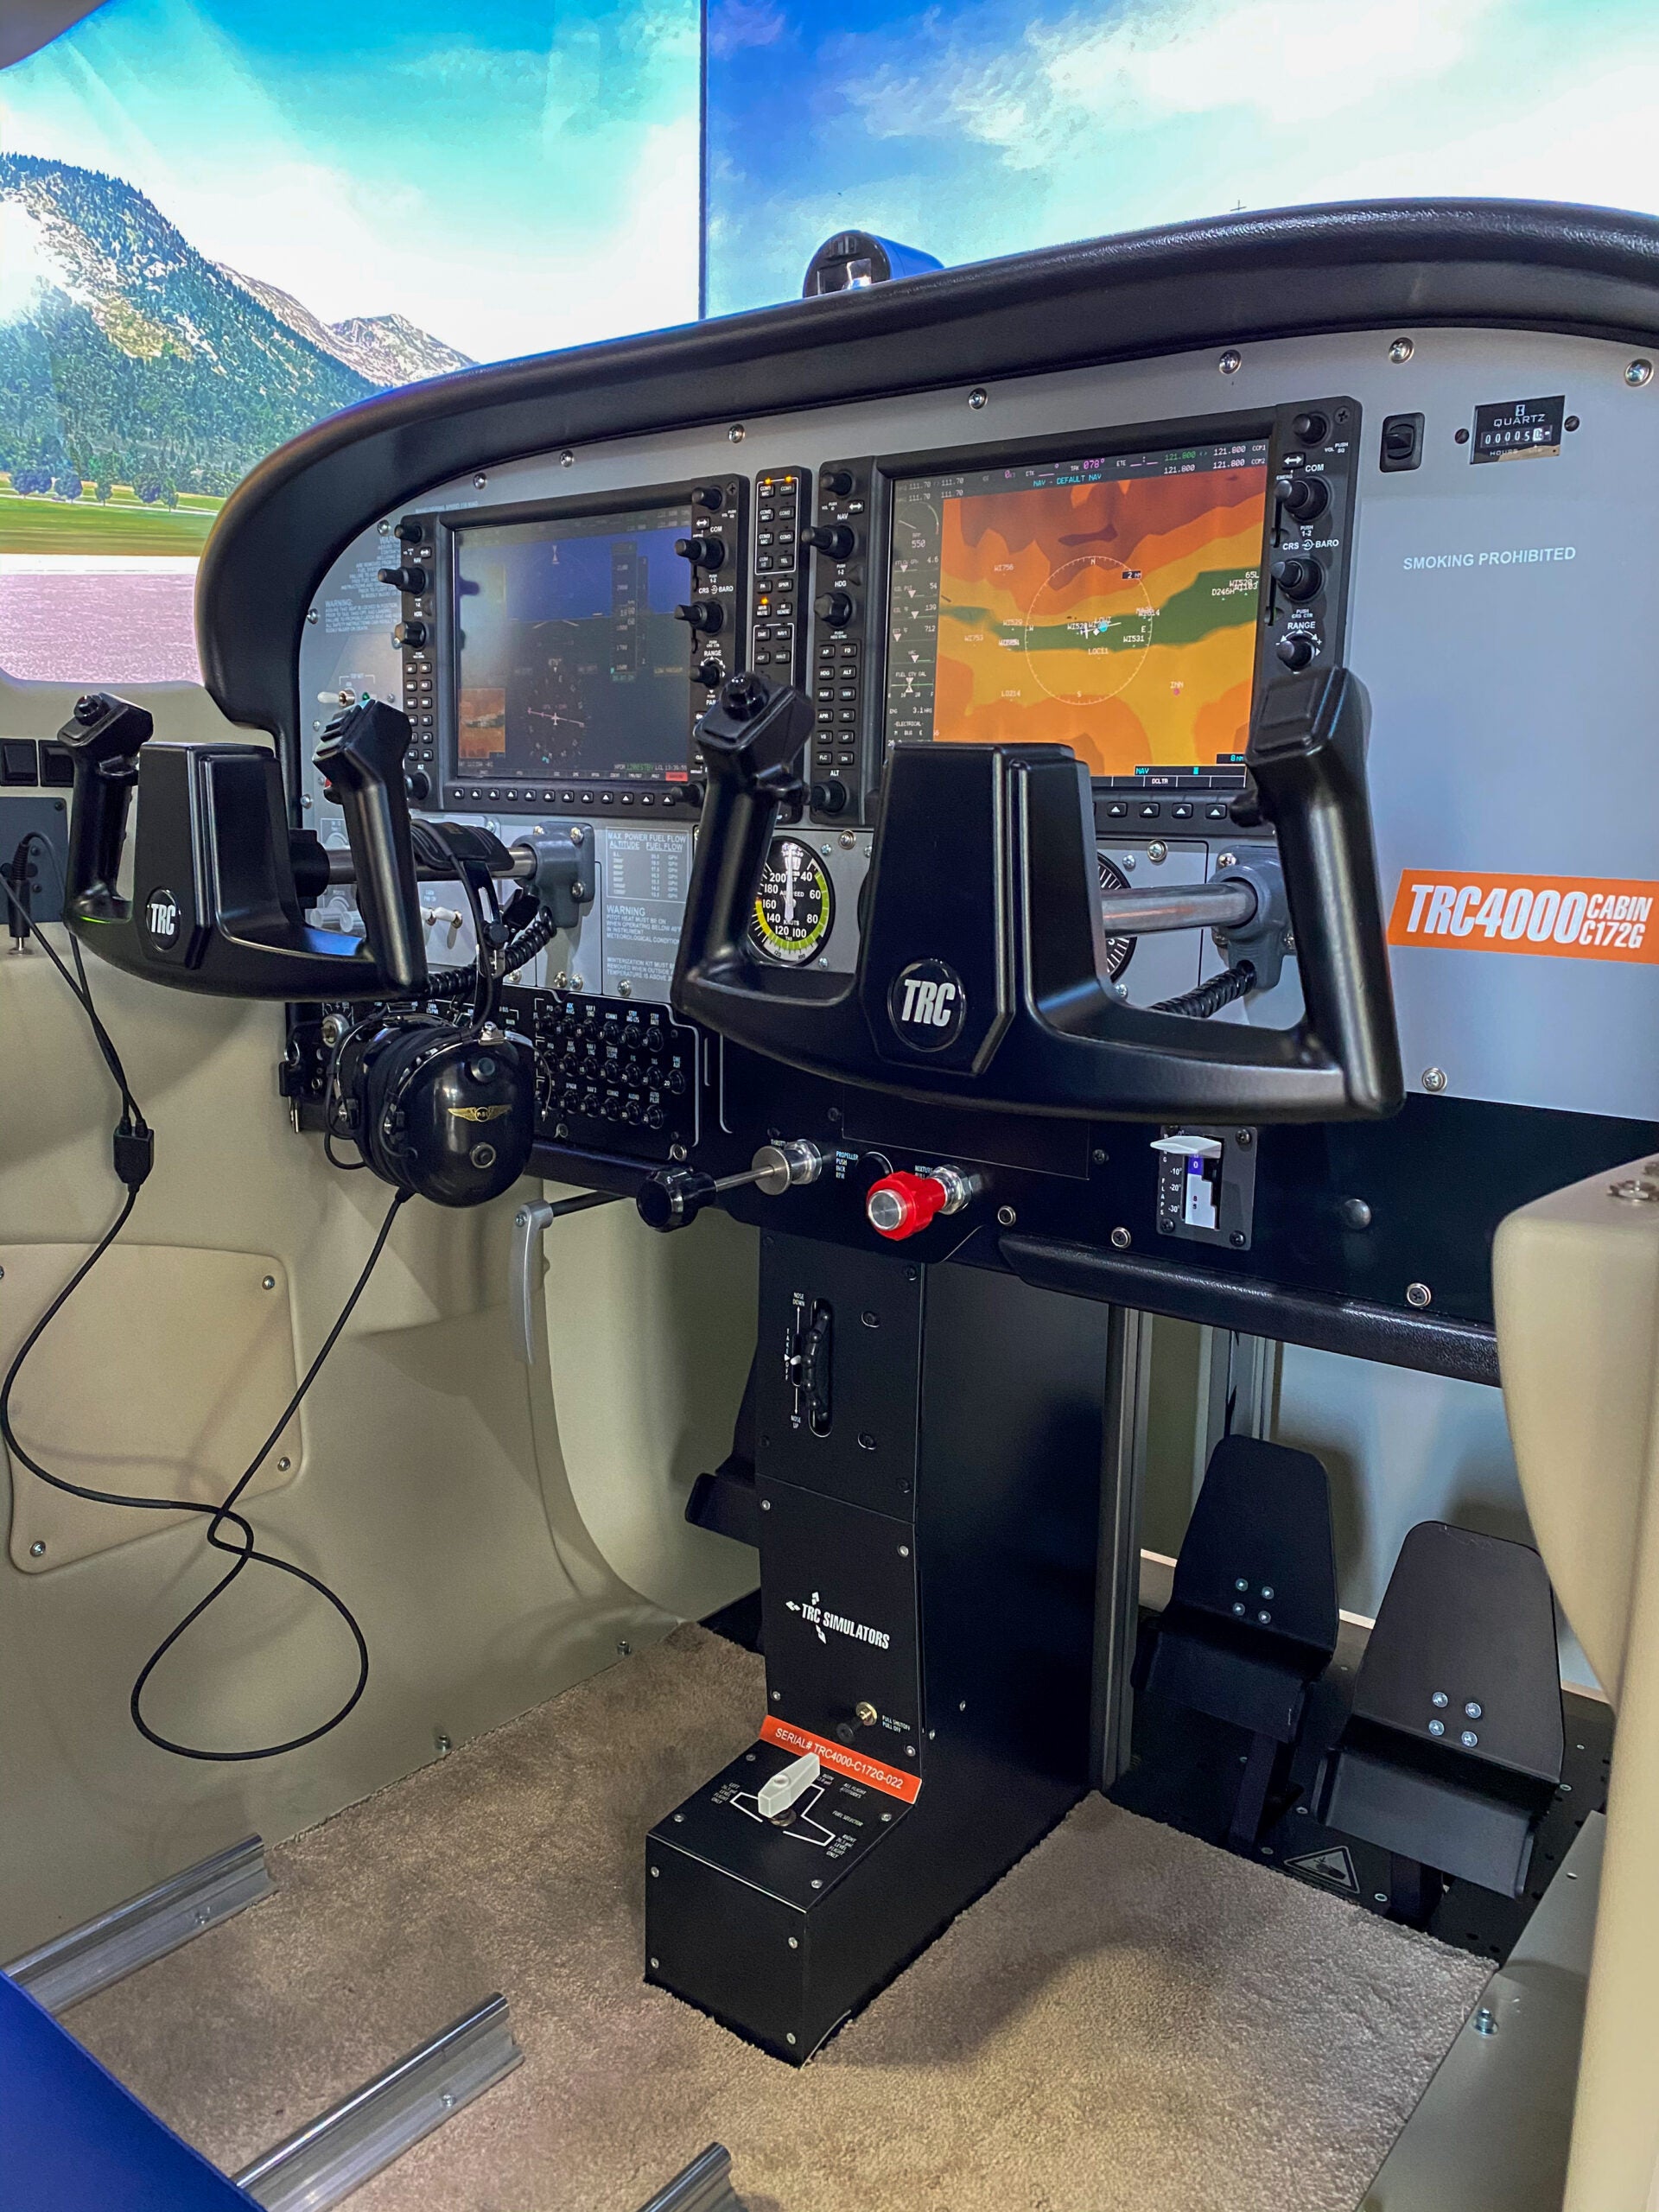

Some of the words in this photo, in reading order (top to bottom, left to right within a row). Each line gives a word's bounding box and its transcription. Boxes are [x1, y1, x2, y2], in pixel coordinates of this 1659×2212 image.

[1493, 414, 1546, 428] QUARTZ
[1213, 445, 1246, 456] 121.800
[1164, 464, 1196, 474] 121.800
[1212, 459, 1245, 469] 121.800
[1305, 464, 1325, 473] COM
[1033, 479, 1046, 487] NAV
[1057, 474, 1086, 485] DEFAULT
[1282, 542, 1300, 551] CRS
[1314, 538, 1339, 549] BARO
[1403, 553, 1474, 570] SMOKING
[1478, 546, 1576, 566] PROHIBITED
[1287, 620, 1316, 630] RANGE
[1135, 766, 1150, 775] NAV
[624, 833, 648, 842] POWER
[649, 834, 665, 842] FUEL
[667, 835, 686, 843] FLOW
[609, 840, 640, 849] ALTITUDE
[645, 842, 663, 850] FUEL
[664, 842, 683, 851] FLOW
[769, 873, 786, 883] 200
[800, 871, 813, 881] 40
[764, 884, 779, 894] 180
[809, 889, 821, 899] 60
[607, 904, 646, 917] WARNING
[762, 899, 777, 910] 160
[150, 903, 176, 936] TRC
[766, 913, 781, 924] 140
[806, 914, 818, 924] 80
[1406, 884, 1588, 944] TRC4000
[1586, 893, 1653, 923] CABIN
[775, 925, 790, 936] 120
[792, 928, 807, 938] 100
[1578, 919, 1646, 949] C172G
[901, 979, 956, 1027] TRC
[836, 1150, 859, 1161] PROPELLER
[836, 1158, 848, 1166] PUSH
[802, 1603, 821, 1624] TRC
[823, 1611, 891, 1649] SIMULATORS
[774, 1727, 812, 1751] SERIAL#
[814, 1743, 905, 1790] TRC4000-C172G-022
